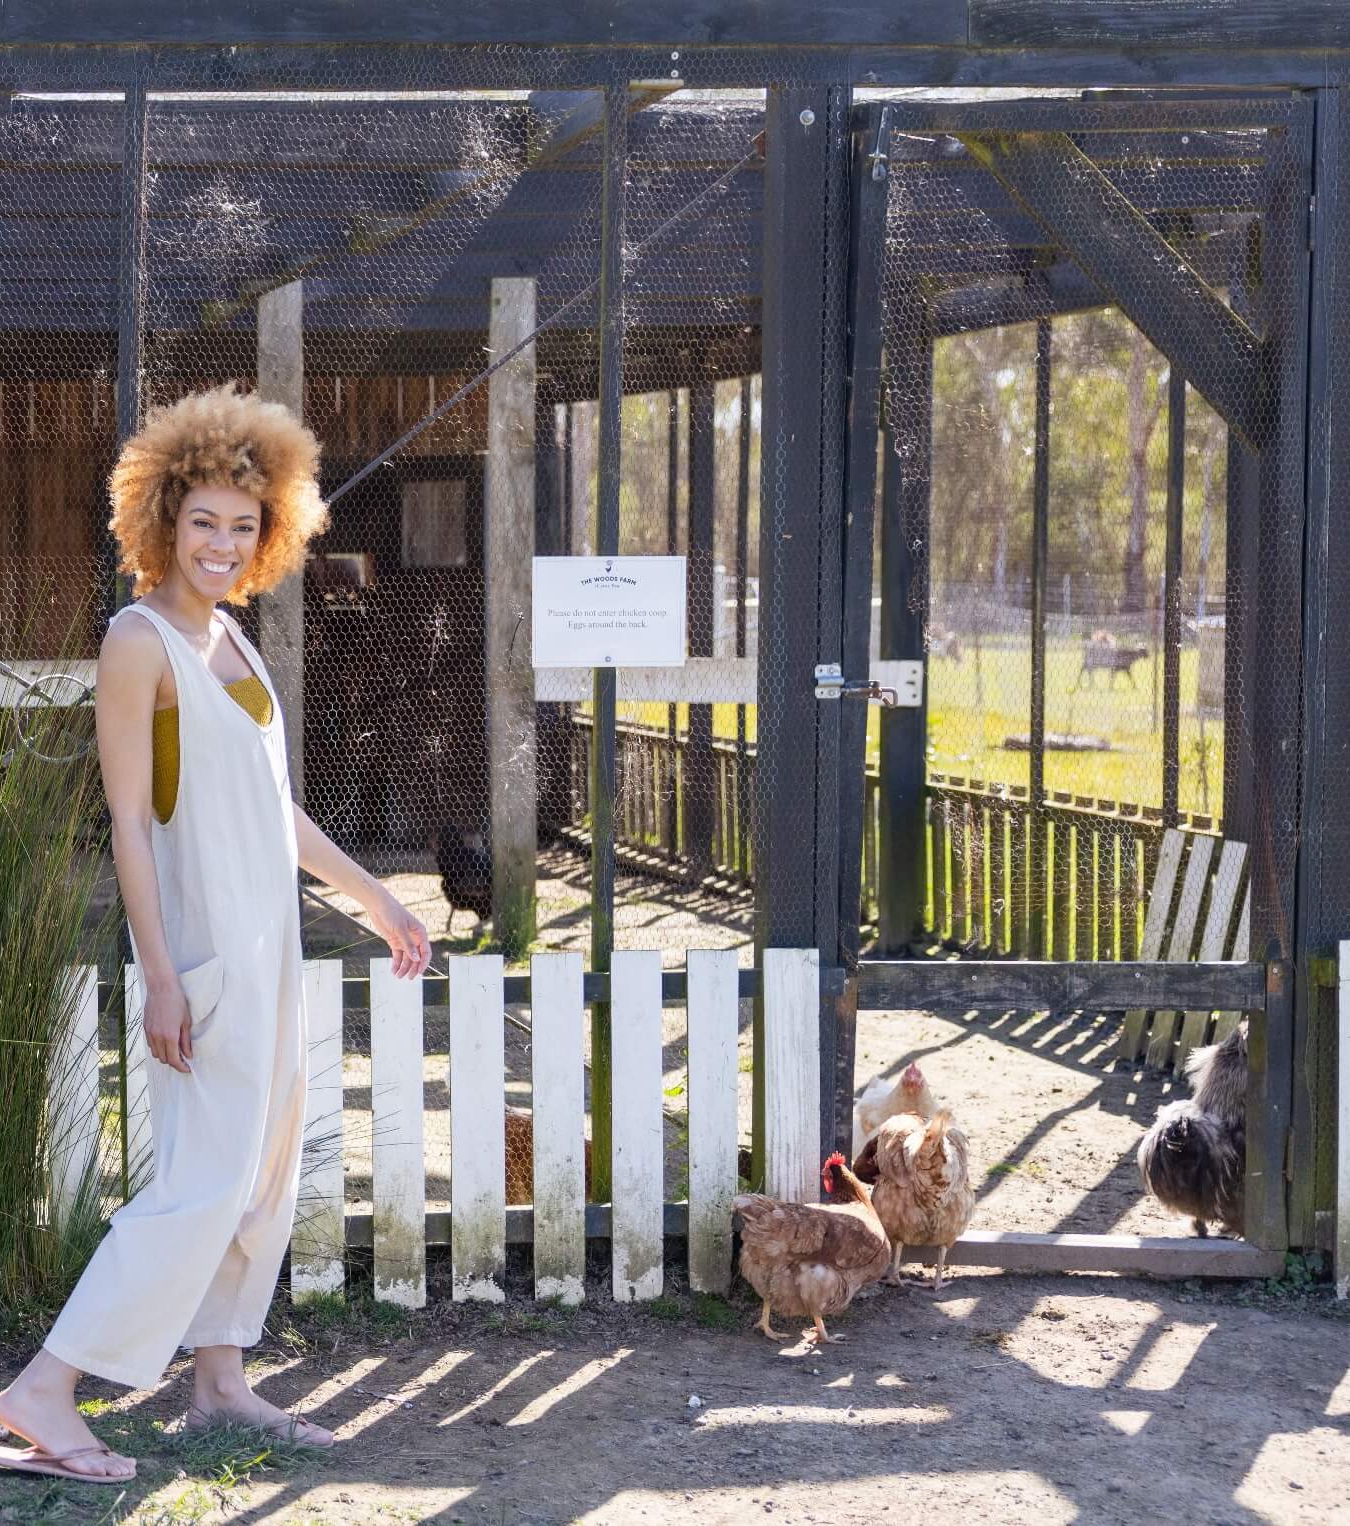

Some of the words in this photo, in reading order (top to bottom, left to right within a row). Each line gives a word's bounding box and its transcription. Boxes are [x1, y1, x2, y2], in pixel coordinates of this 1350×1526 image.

[580, 577, 592, 586] THE
[619, 576, 637, 586] FARM
[547, 608, 571, 617] Please
[572, 608, 583, 617] do
[584, 609, 596, 617] not
[597, 609, 616, 617] enter
[618, 608, 647, 617] chicken
[568, 620, 587, 630] Eggs
[588, 620, 614, 628] around
[615, 620, 627, 628] the
[628, 620, 648, 629] back.
